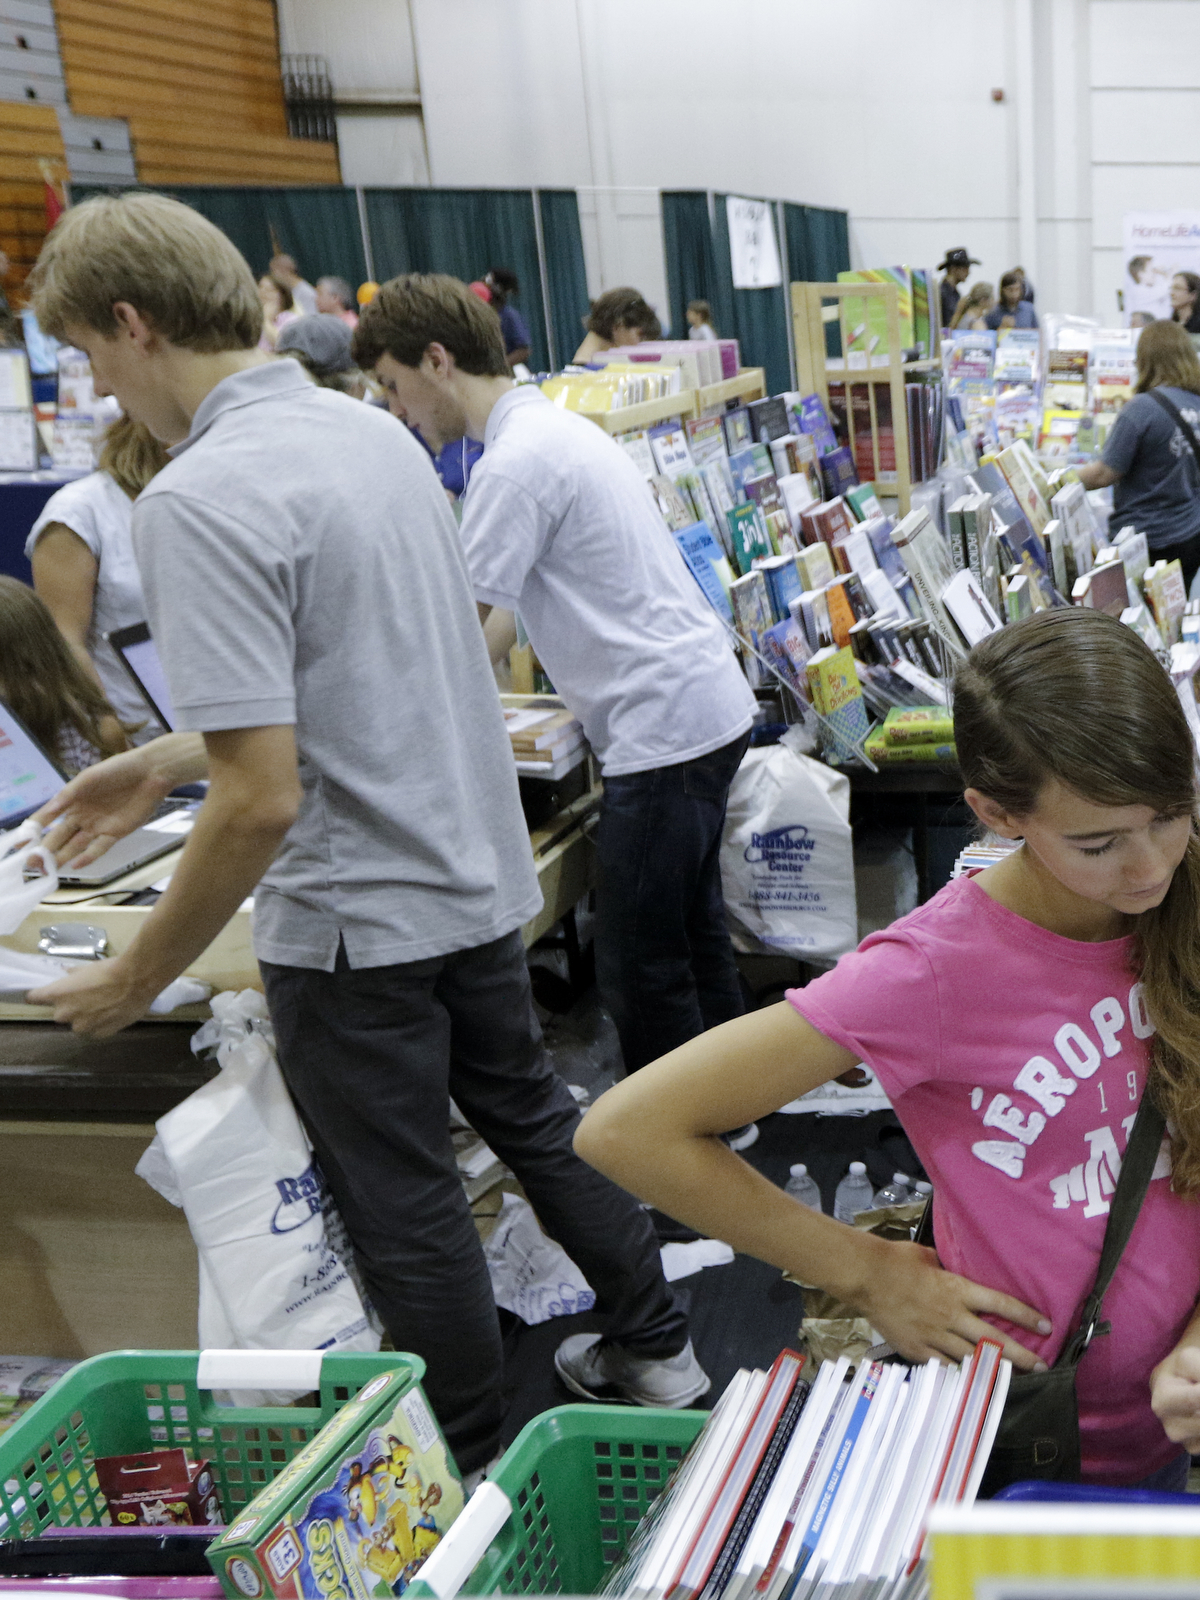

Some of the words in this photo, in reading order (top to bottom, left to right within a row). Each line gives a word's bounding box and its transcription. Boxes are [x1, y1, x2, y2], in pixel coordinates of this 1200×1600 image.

[966, 536, 980, 567] ACTION
[912, 571, 941, 615] UNVEILING
[751, 832, 816, 851] Rainbow
[761, 850, 811, 862] Resource
[768, 861, 804, 873] Center
[865, 1386, 877, 1401] TOP
[789, 1496, 803, 1515] Cool
[796, 1460, 817, 1496] Creations
[810, 1492, 832, 1534] MAGNETIC
[826, 1469, 840, 1494] SILLY
[834, 1437, 854, 1472] ANIMALS
[272, 1548, 285, 1571] AGES
[279, 1538, 297, 1564] 3+
